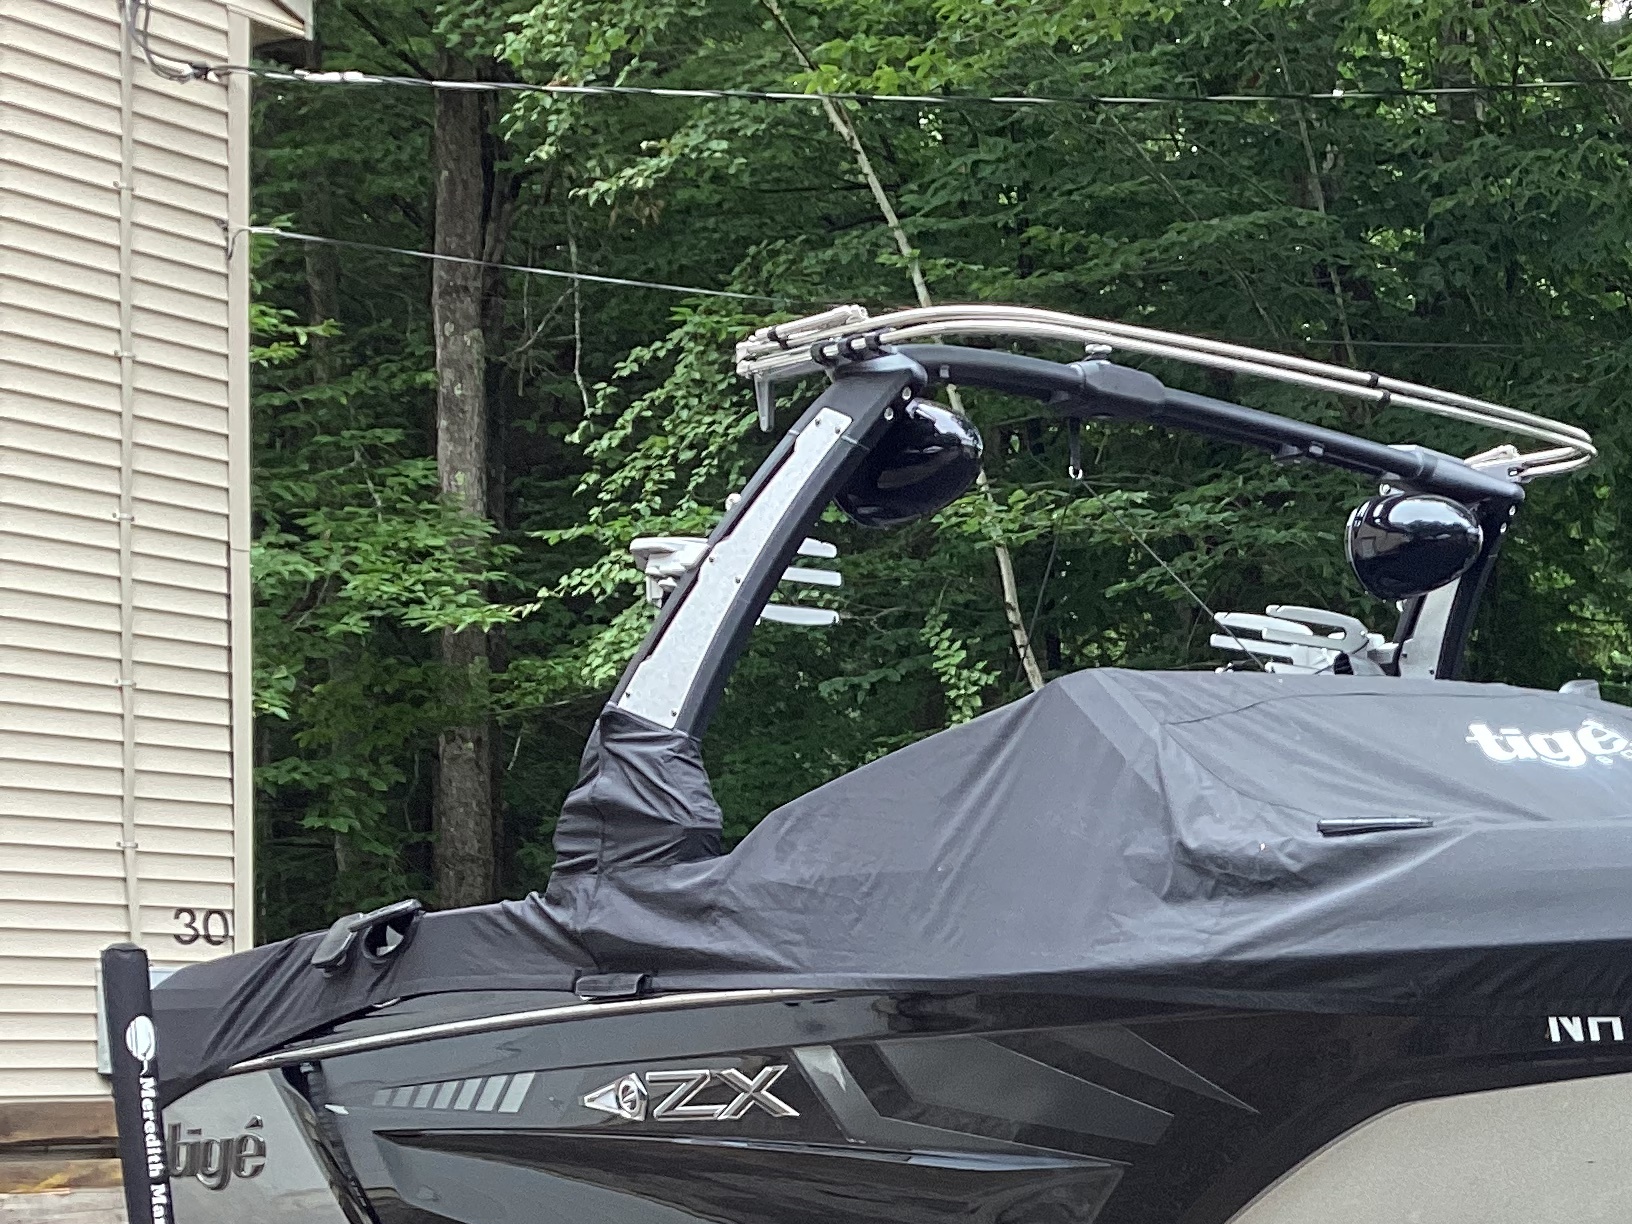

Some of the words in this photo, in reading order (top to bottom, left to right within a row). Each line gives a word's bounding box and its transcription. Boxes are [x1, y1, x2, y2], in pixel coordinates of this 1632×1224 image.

[174, 908, 229, 946] 30
[646, 1064, 800, 1122] ZX
[140, 1077, 166, 1178] Meredith
